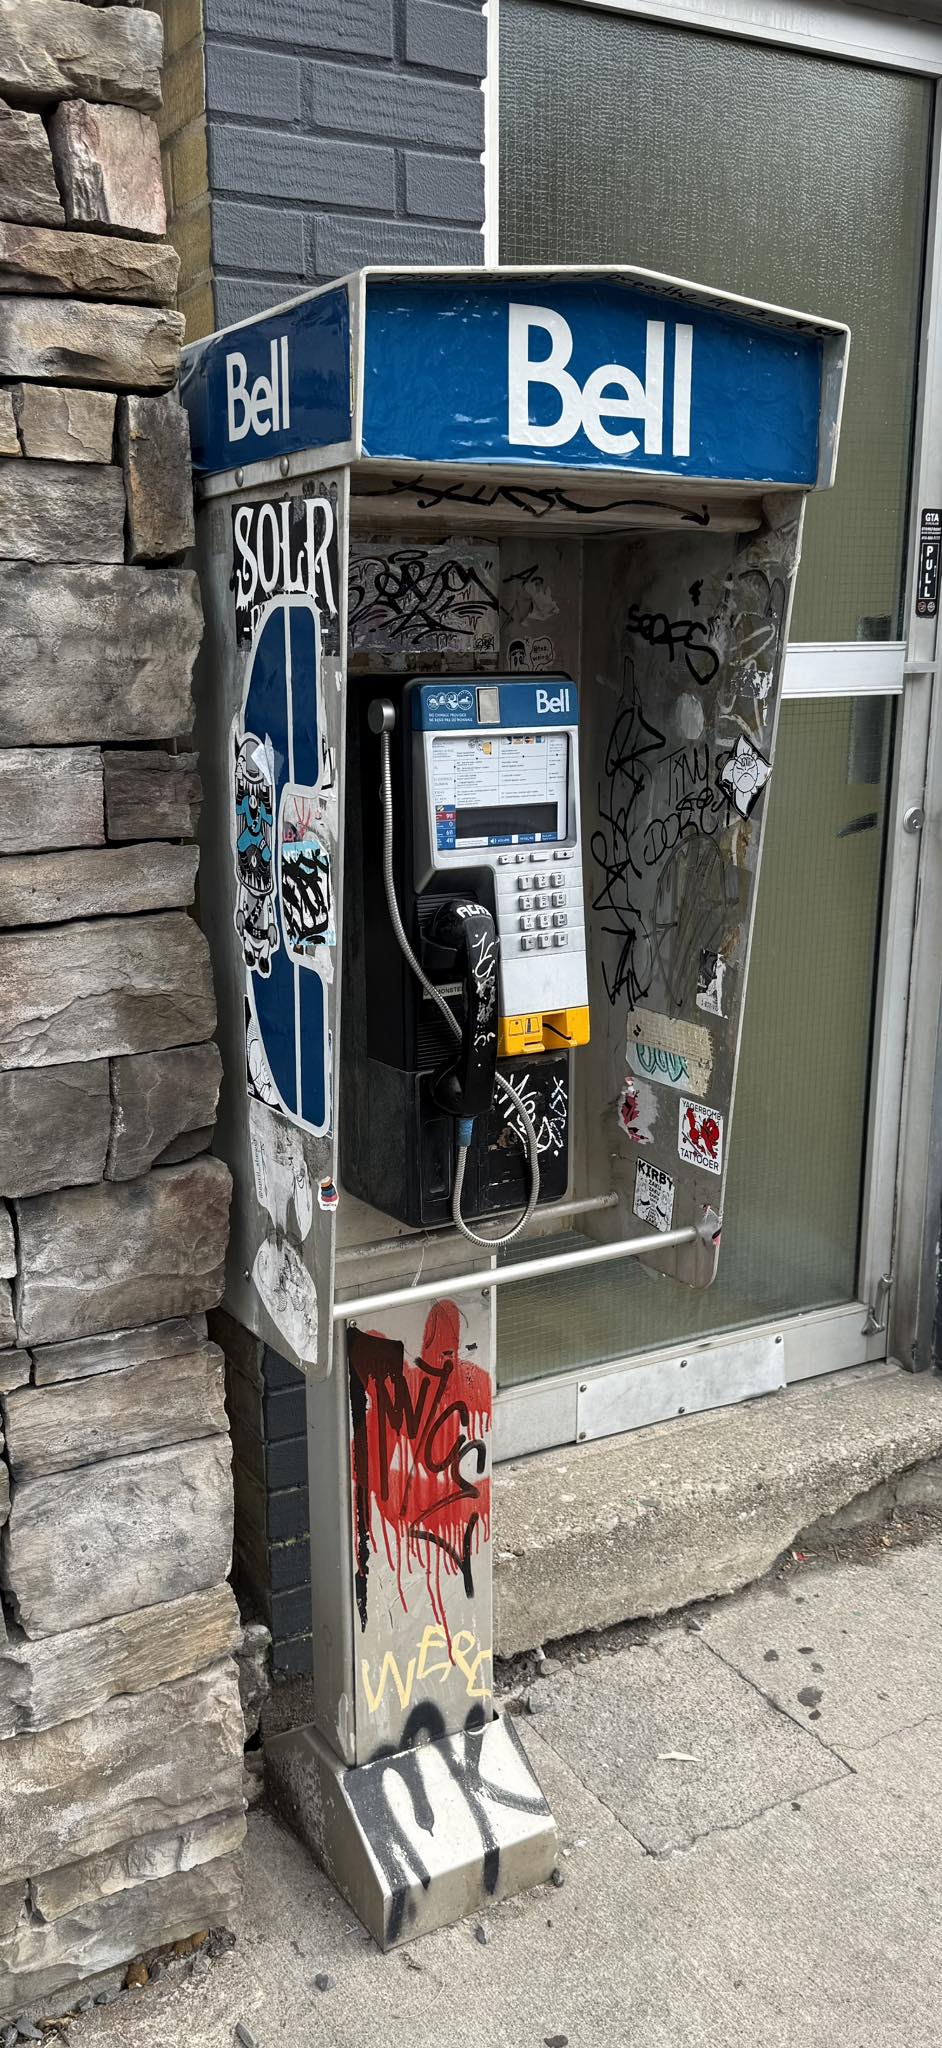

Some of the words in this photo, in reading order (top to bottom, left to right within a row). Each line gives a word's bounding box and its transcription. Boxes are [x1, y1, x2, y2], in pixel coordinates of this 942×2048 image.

[226, 335, 290, 442] Bell
[508, 303, 694, 457] Bell
[925, 513, 939, 522] GTA
[234, 497, 338, 617] SOLR
[923, 545, 934, 597] PULL
[536, 688, 570, 713] Bell
[638, 1159, 673, 1191] KIRBY
[680, 1147, 719, 1171] TATTOOER
